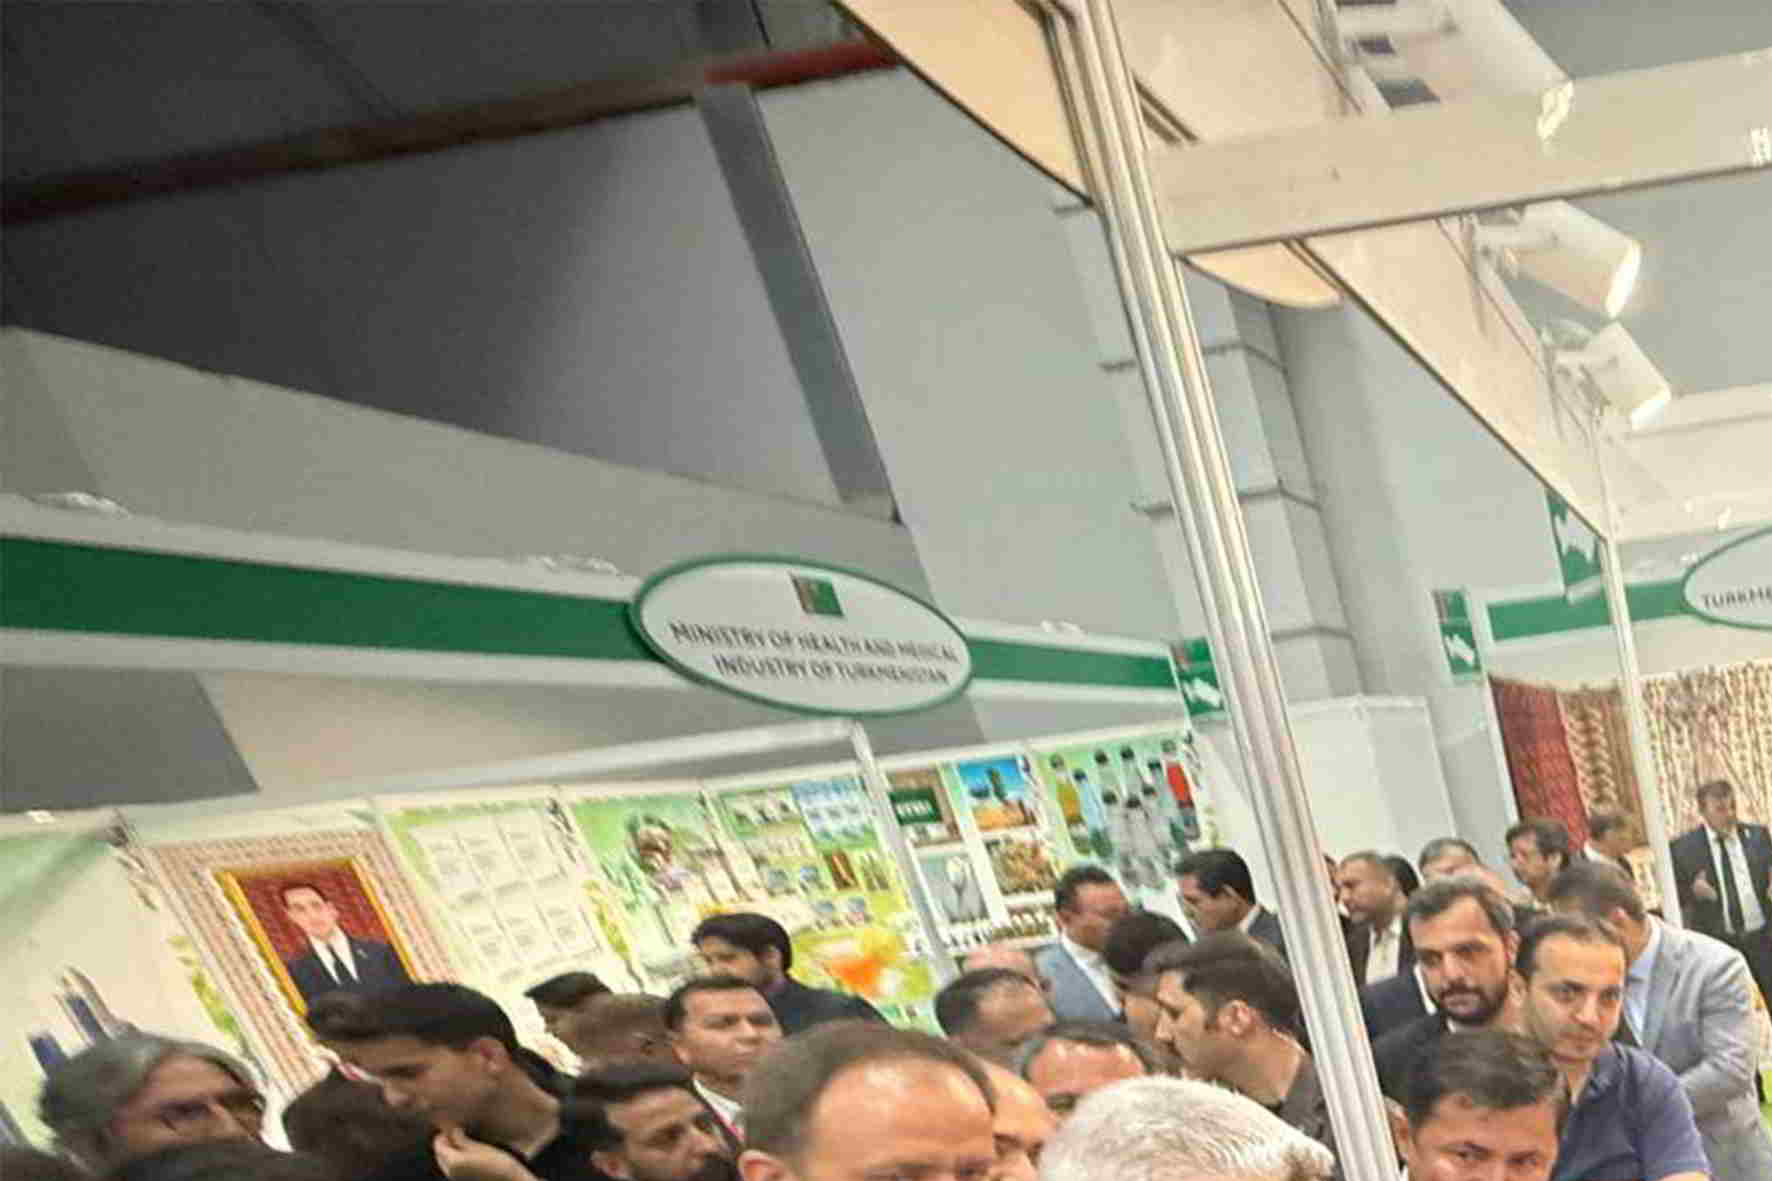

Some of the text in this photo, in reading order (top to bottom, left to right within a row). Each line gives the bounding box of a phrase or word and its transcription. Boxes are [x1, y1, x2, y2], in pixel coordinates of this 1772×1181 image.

[669, 620, 766, 648] MINISTRY
[768, 630, 793, 649] OF
[797, 632, 862, 657] HEALTH
[712, 654, 810, 679] INDUSTRY
[811, 661, 836, 680] OF
